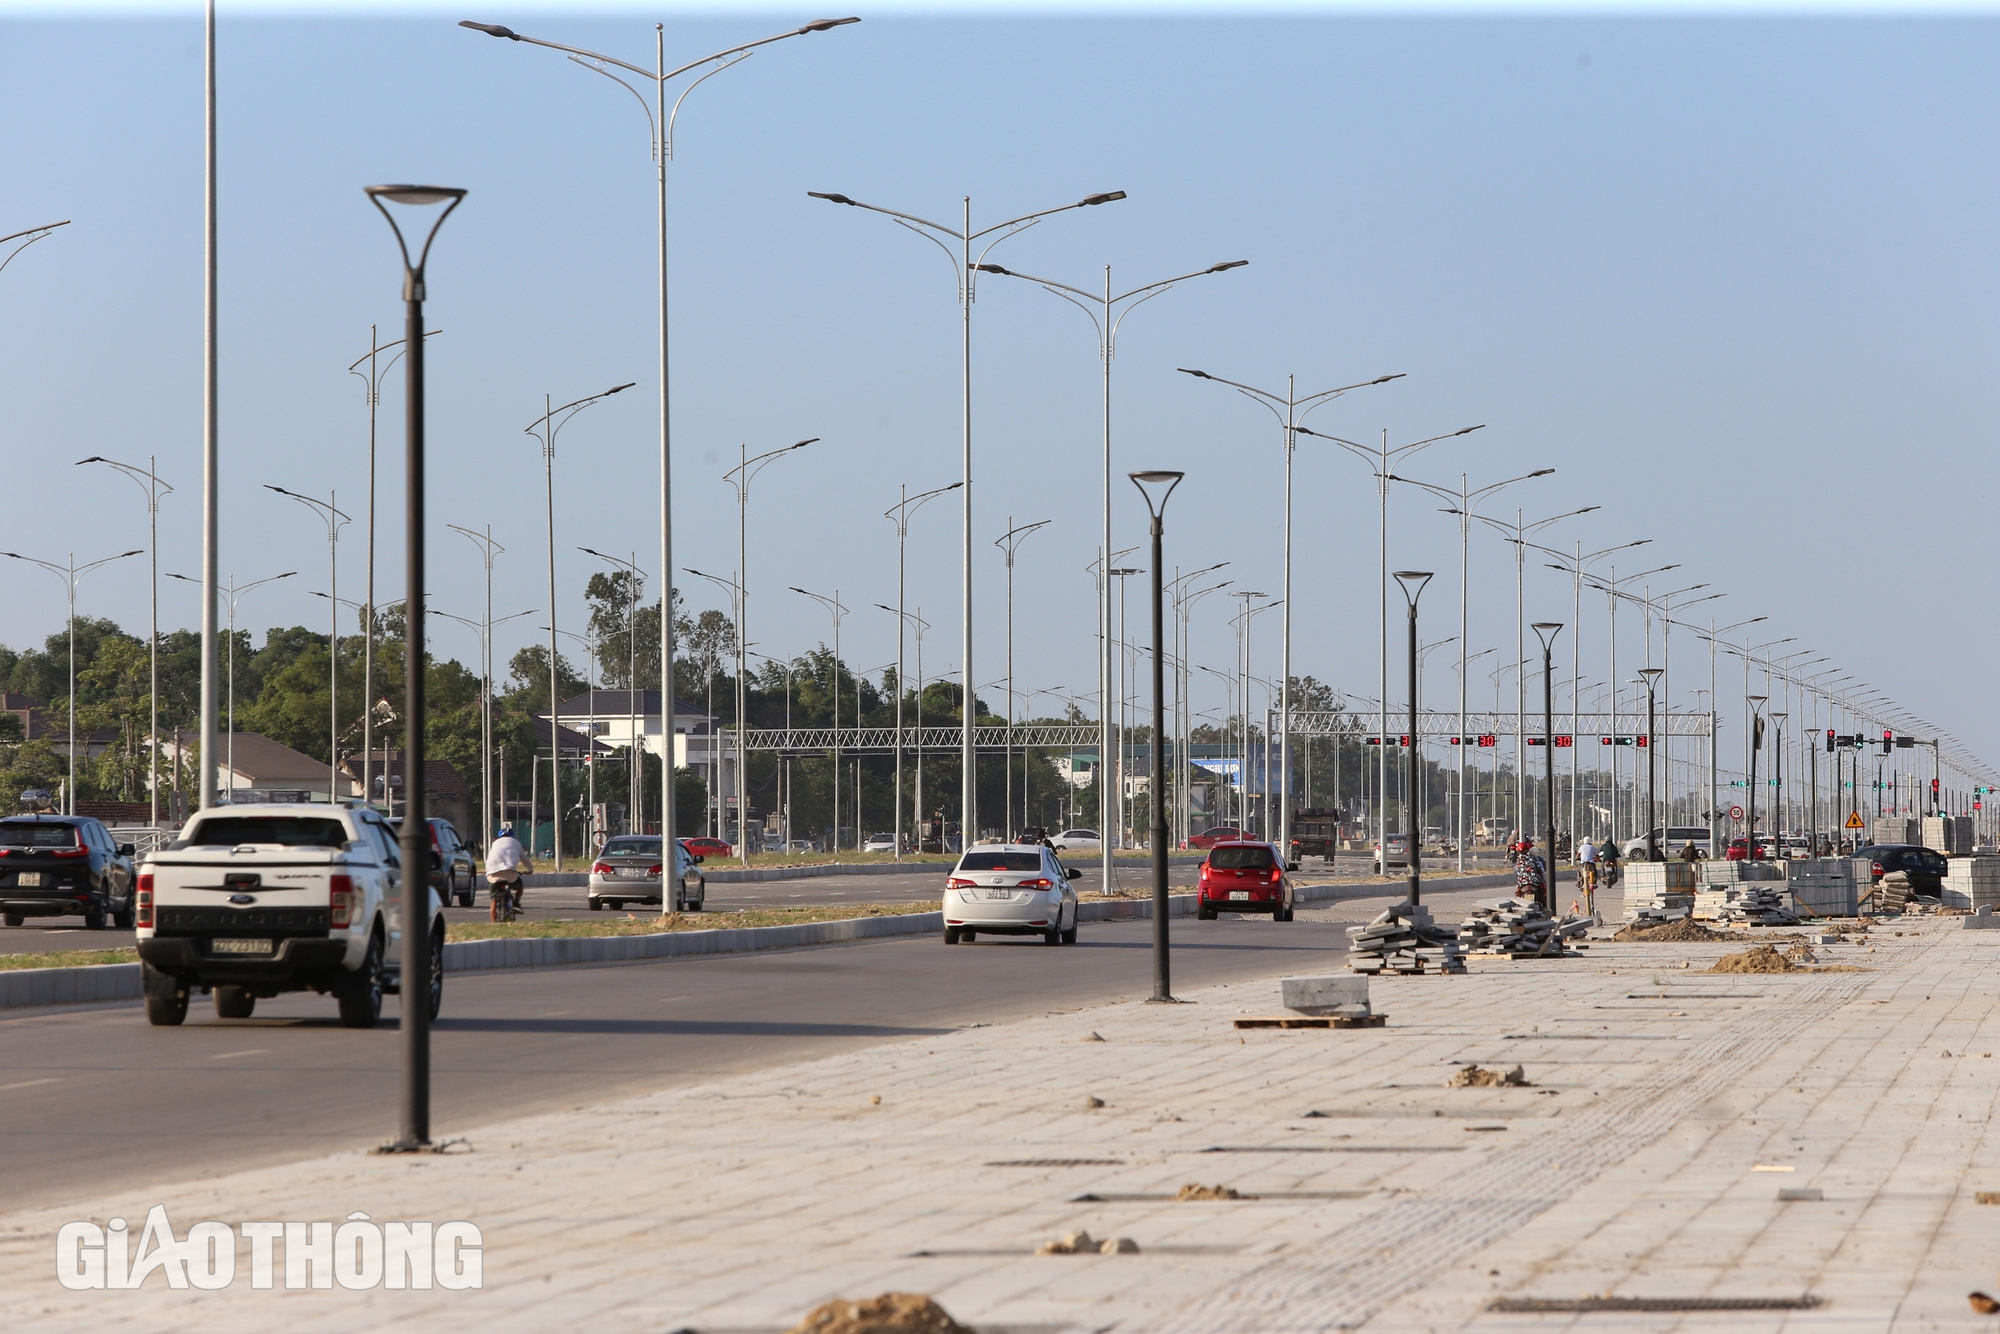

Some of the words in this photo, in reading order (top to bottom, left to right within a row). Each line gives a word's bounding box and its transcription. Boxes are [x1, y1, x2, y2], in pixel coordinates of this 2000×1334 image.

[1480, 736, 1494, 748] 30
[1556, 736, 1571, 747] 30
[163, 914, 323, 924] RANGER
